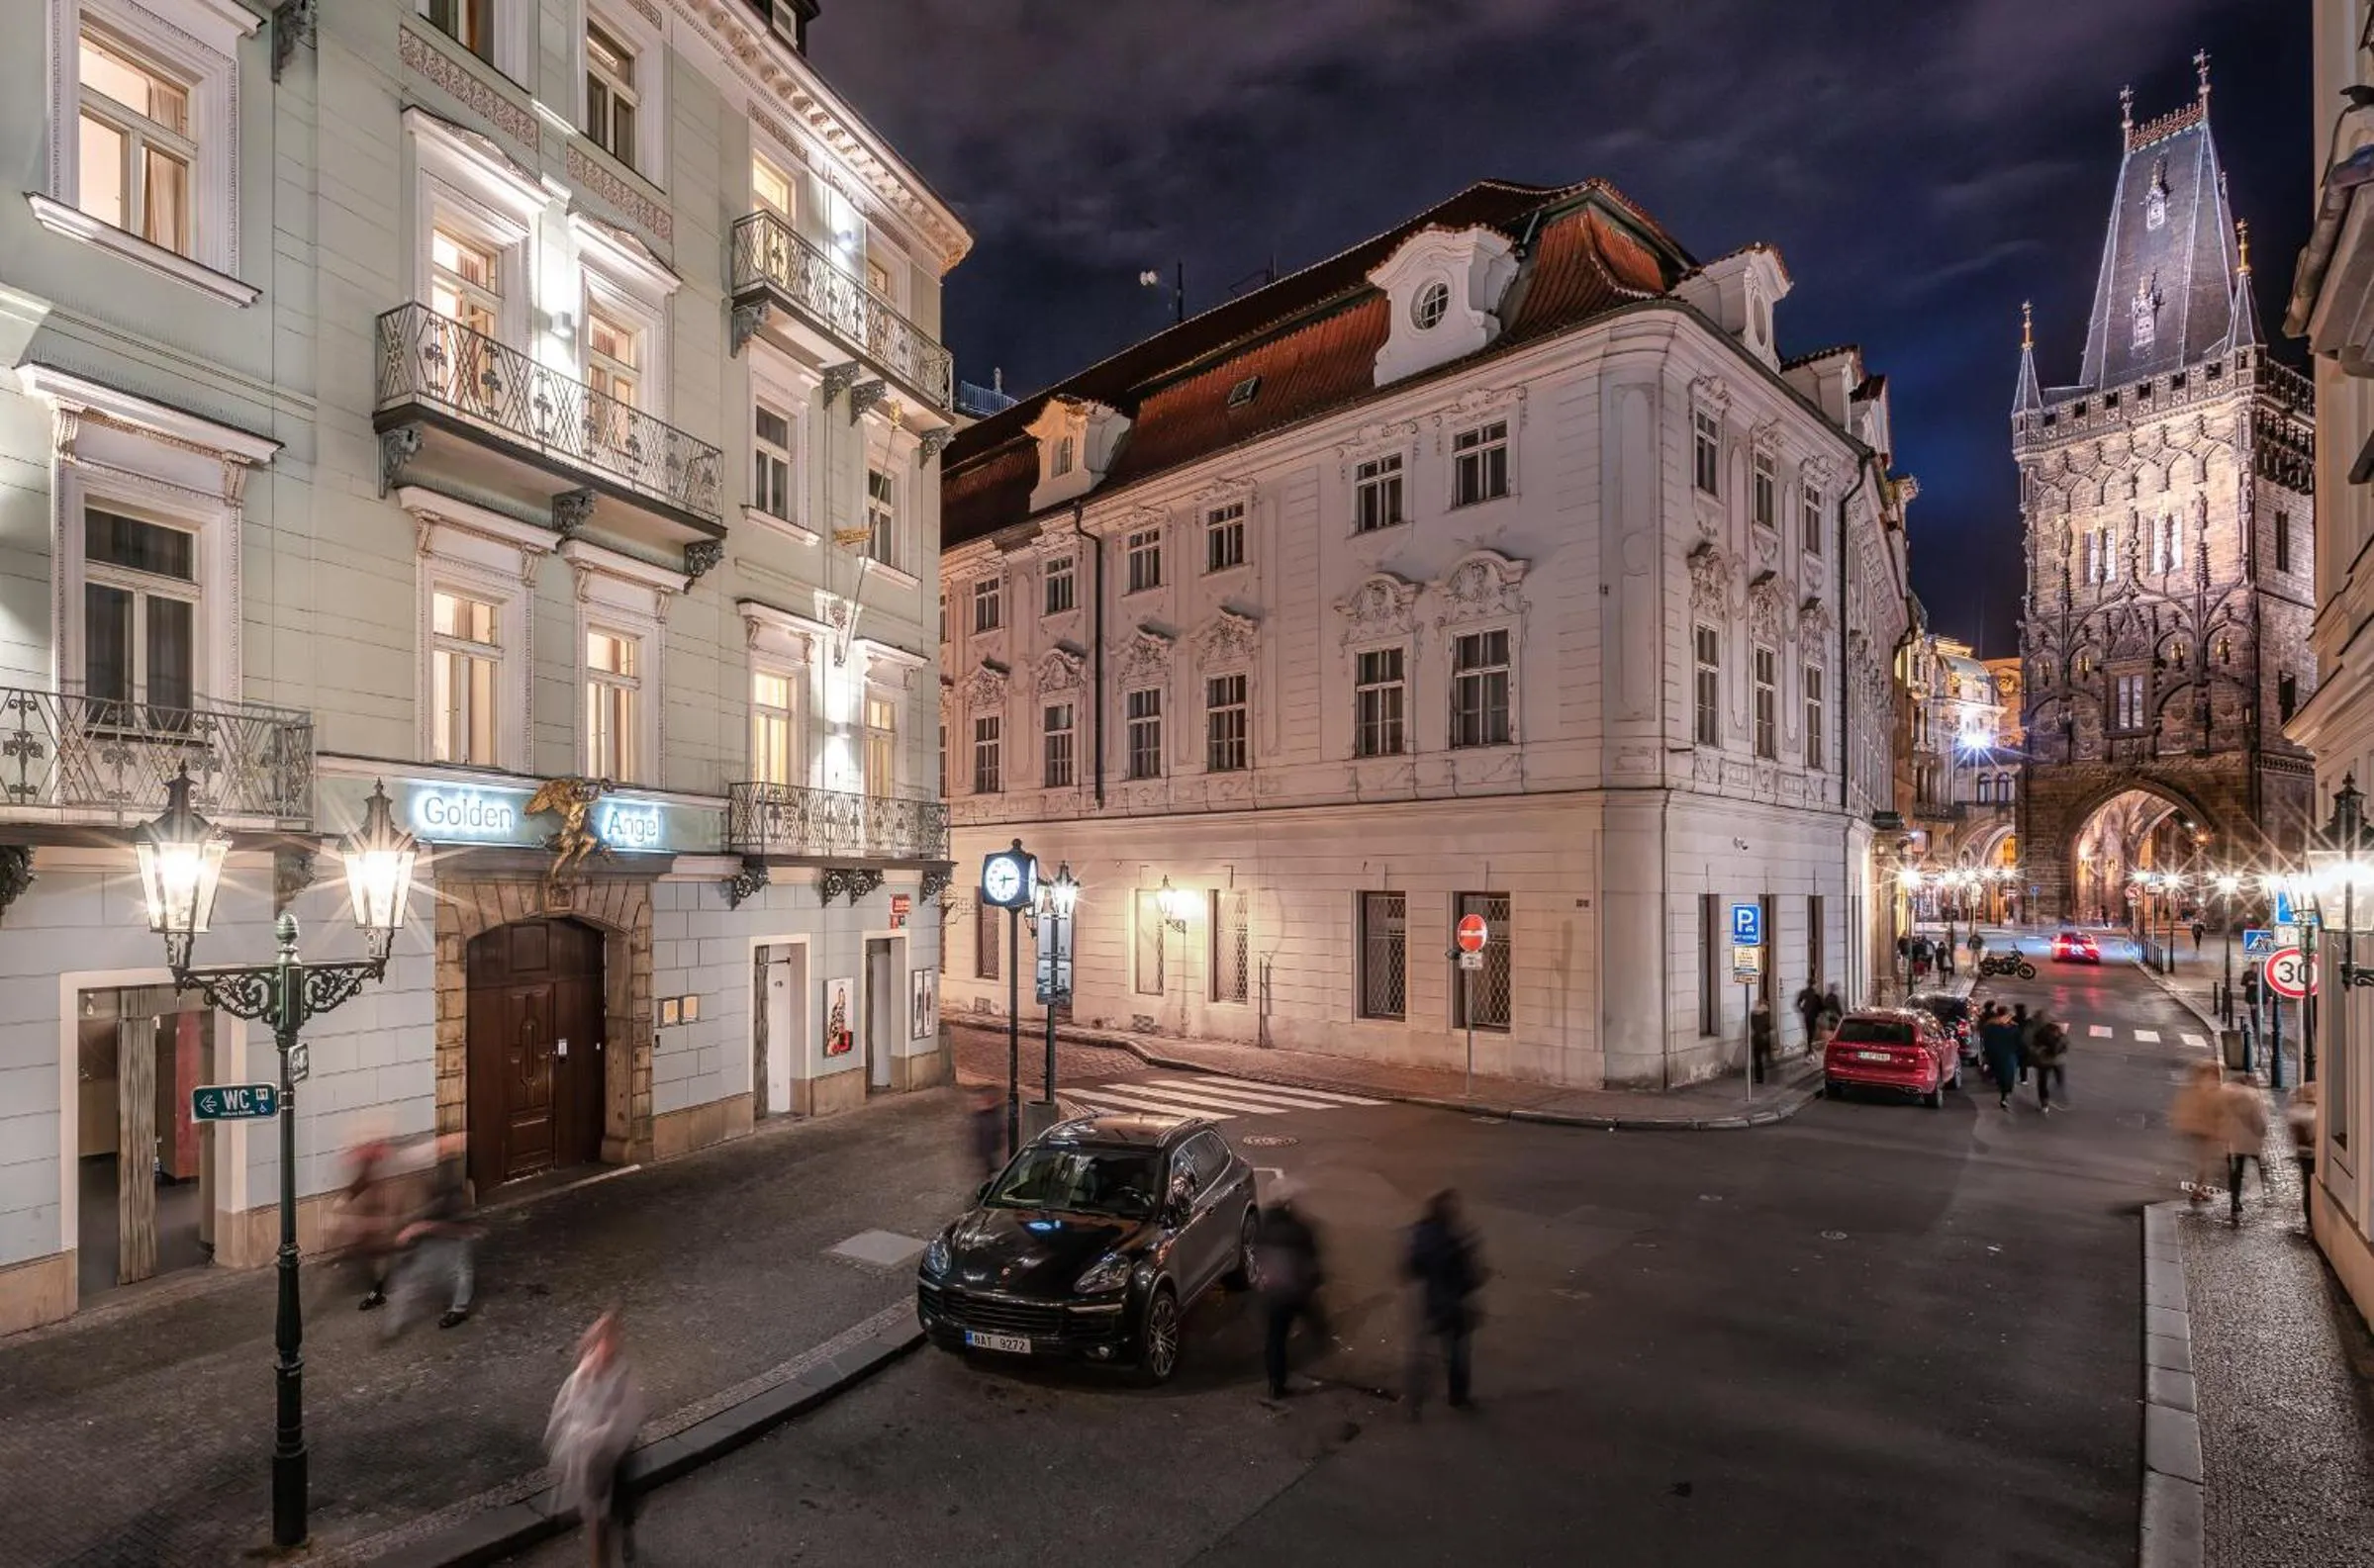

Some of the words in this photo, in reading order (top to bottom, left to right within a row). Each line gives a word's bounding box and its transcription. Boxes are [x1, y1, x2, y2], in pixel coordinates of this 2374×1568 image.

[424, 795, 514, 829] Golden
[606, 809, 662, 844] Angel
[1737, 909, 1755, 933] P
[2278, 961, 2313, 984] 30
[222, 1089, 250, 1110] WC
